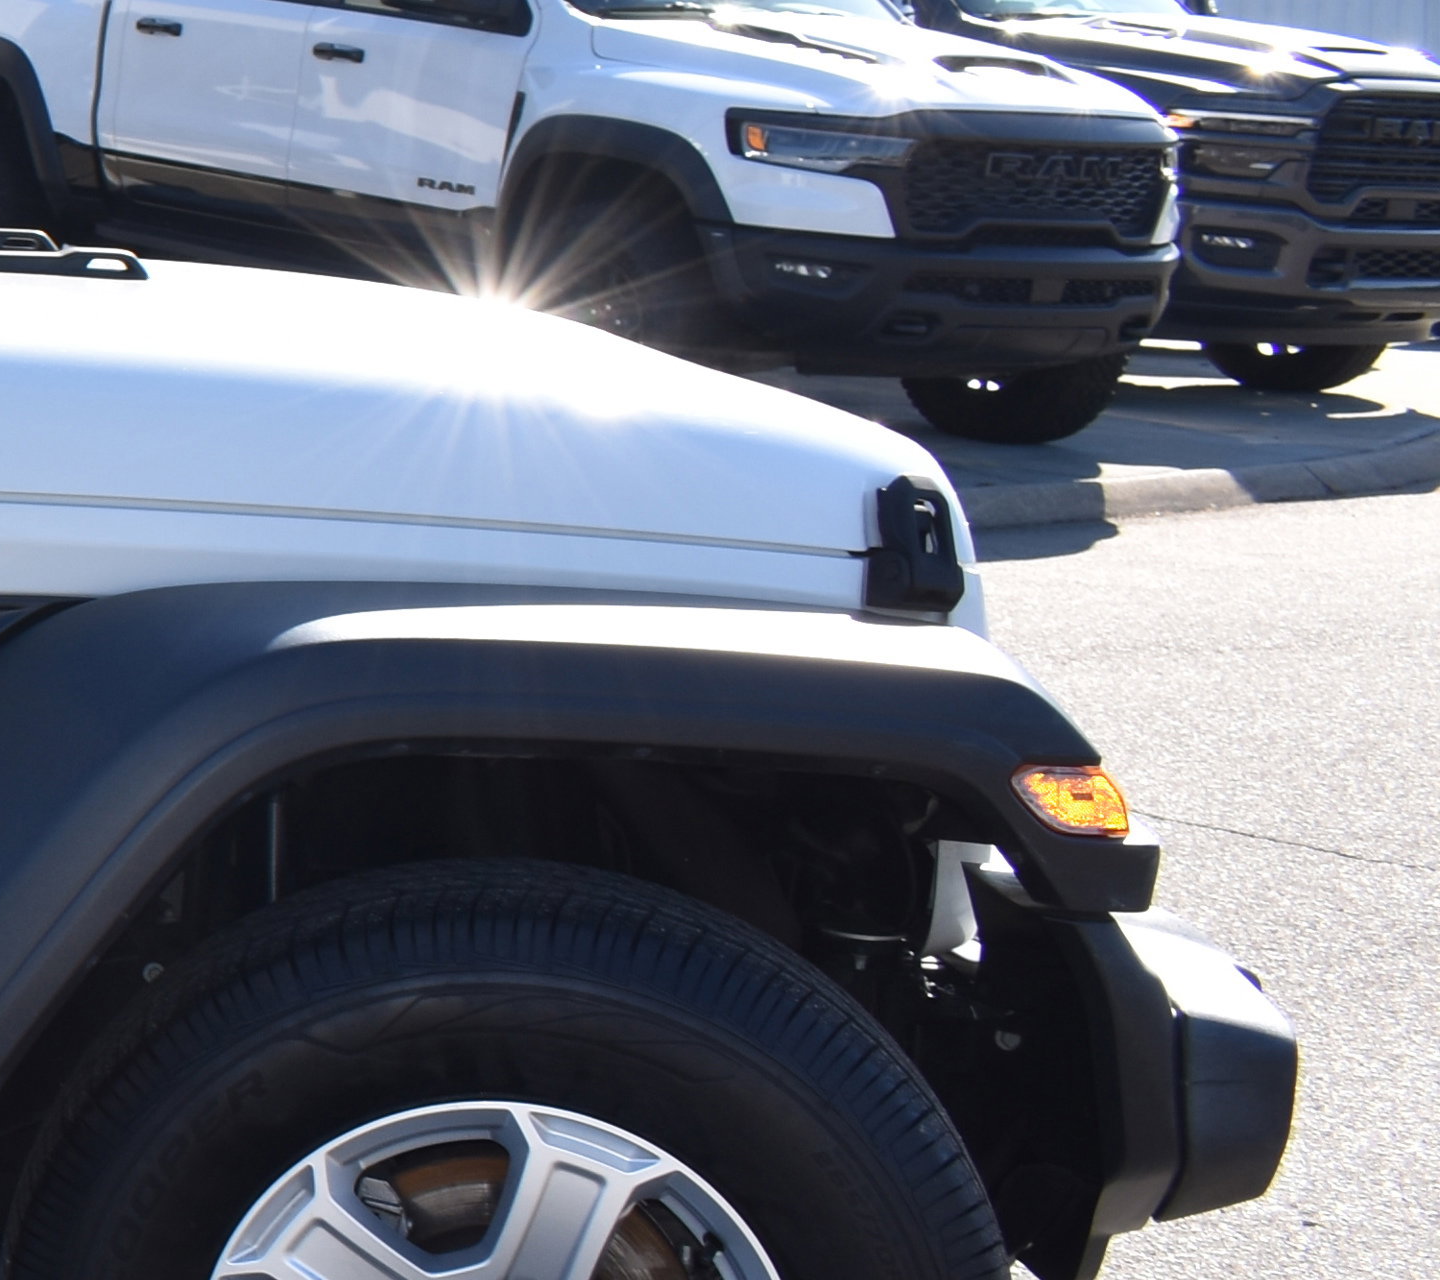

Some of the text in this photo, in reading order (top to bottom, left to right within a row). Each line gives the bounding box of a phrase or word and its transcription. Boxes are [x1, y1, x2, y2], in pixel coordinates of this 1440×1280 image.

[1375, 117, 1440, 140] RA
[986, 152, 1124, 182] RAM
[417, 177, 476, 196] RAM
